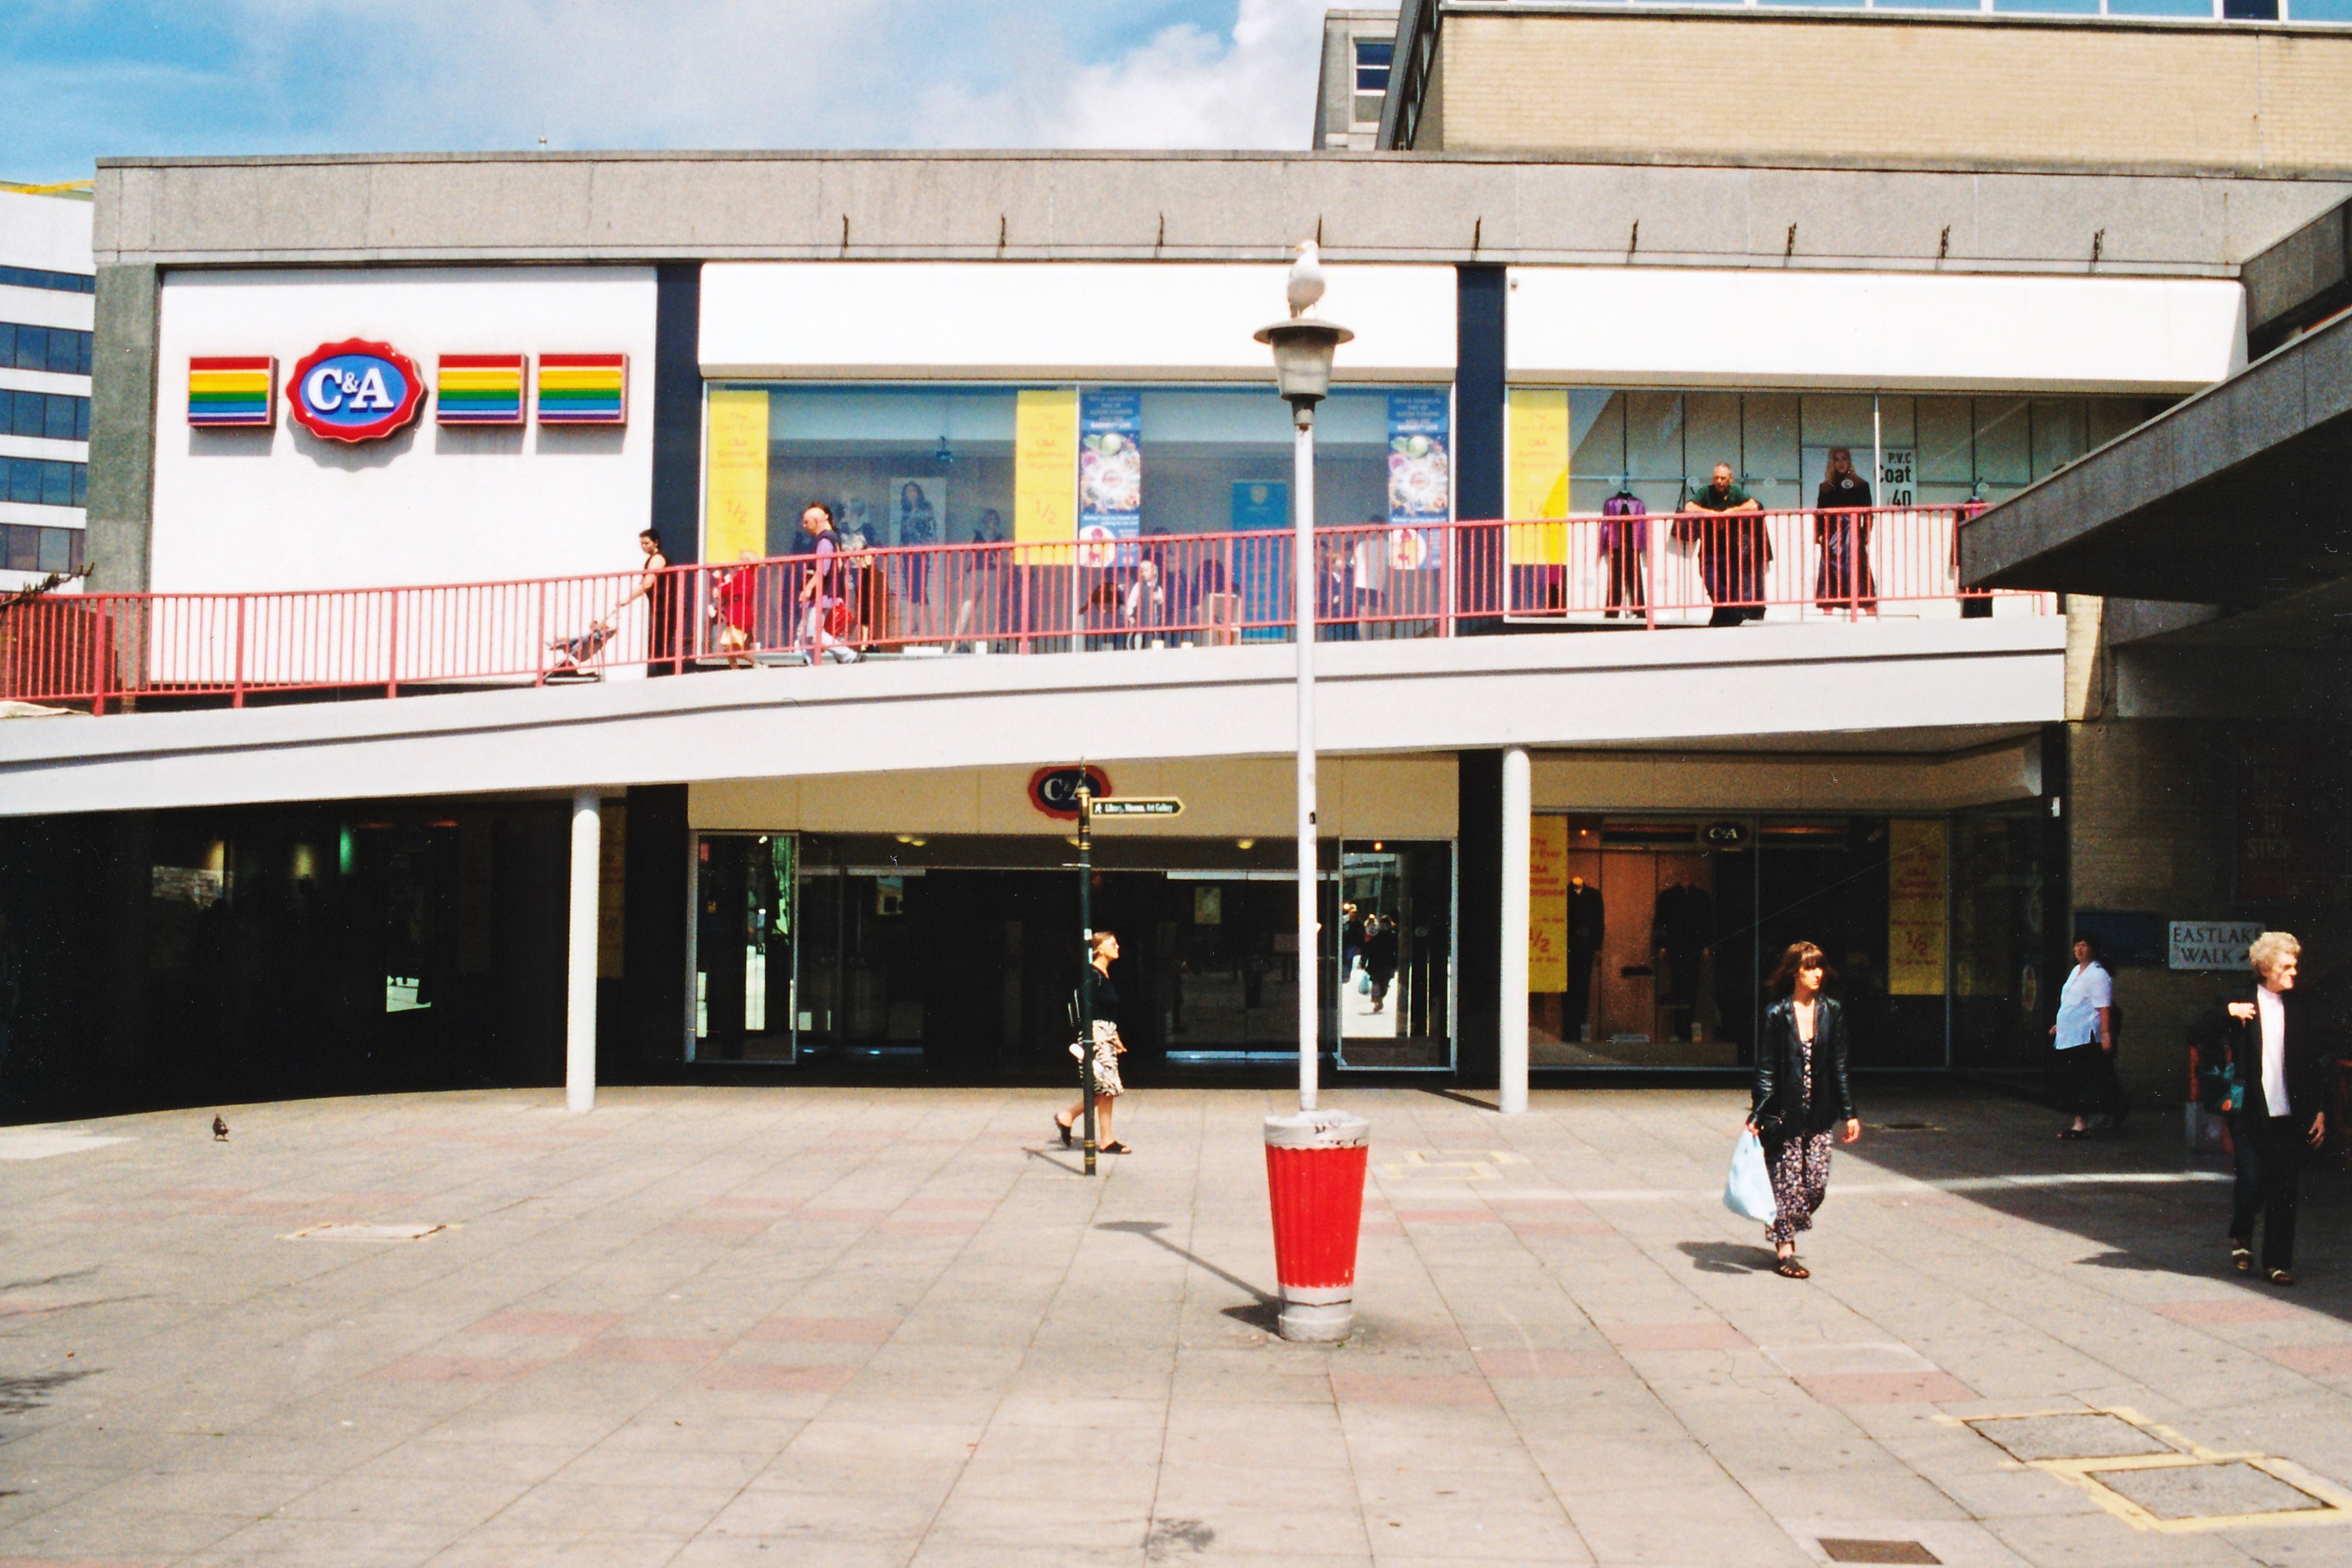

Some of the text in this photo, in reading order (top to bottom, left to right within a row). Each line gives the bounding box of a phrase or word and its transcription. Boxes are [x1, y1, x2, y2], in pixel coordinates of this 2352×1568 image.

[308, 368, 395, 410] C&A
[1527, 438, 1547, 447] C&A
[1708, 827, 1739, 839] C&A
[2181, 948, 2234, 963] WALK
